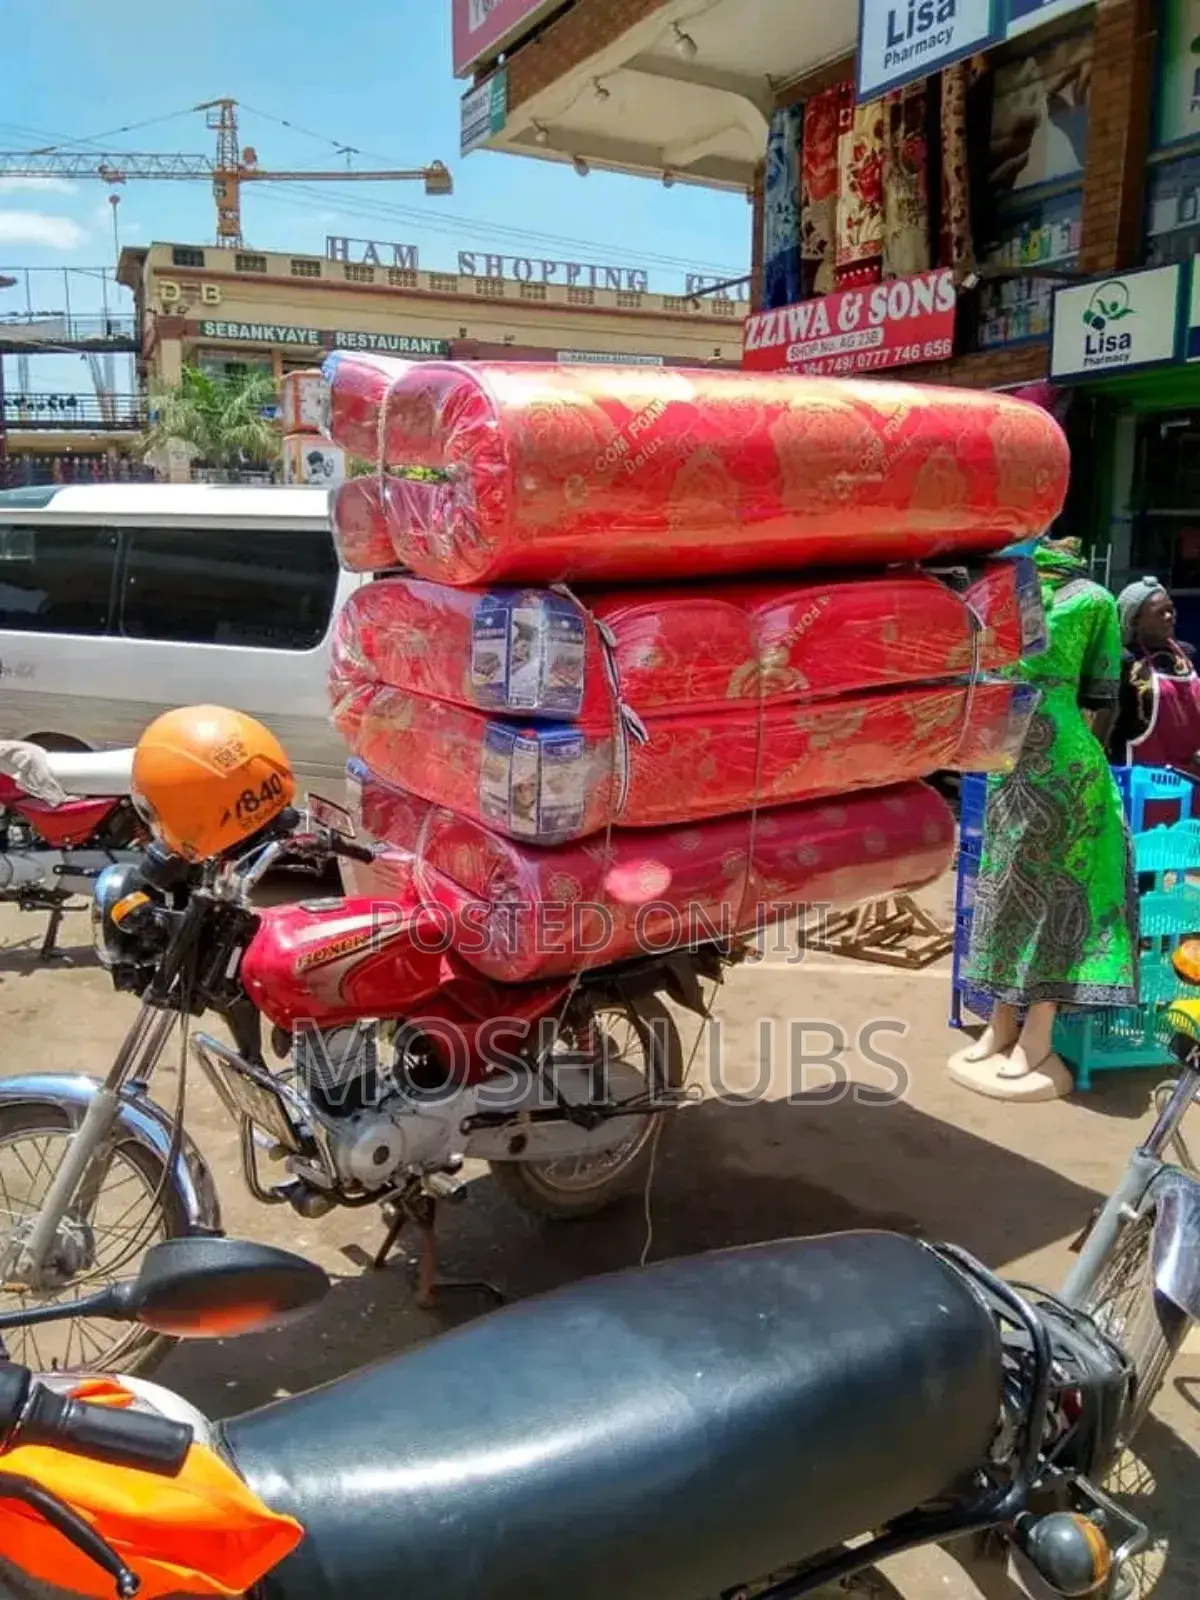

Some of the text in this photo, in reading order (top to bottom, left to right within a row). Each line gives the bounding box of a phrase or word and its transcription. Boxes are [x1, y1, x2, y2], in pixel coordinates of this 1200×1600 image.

[886, 0, 956, 48] Lisa
[883, 26, 954, 70] Pharmacy
[326, 236, 418, 269] HAM
[459, 252, 648, 292] SHOPPING
[745, 271, 956, 350] ZZIWA & SONS
[204, 321, 441, 354] SEBANKYAYE RESTAURANT
[893, 343, 921, 362] 746
[923, 338, 952, 358] 656
[1085, 332, 1132, 355] Lisa
